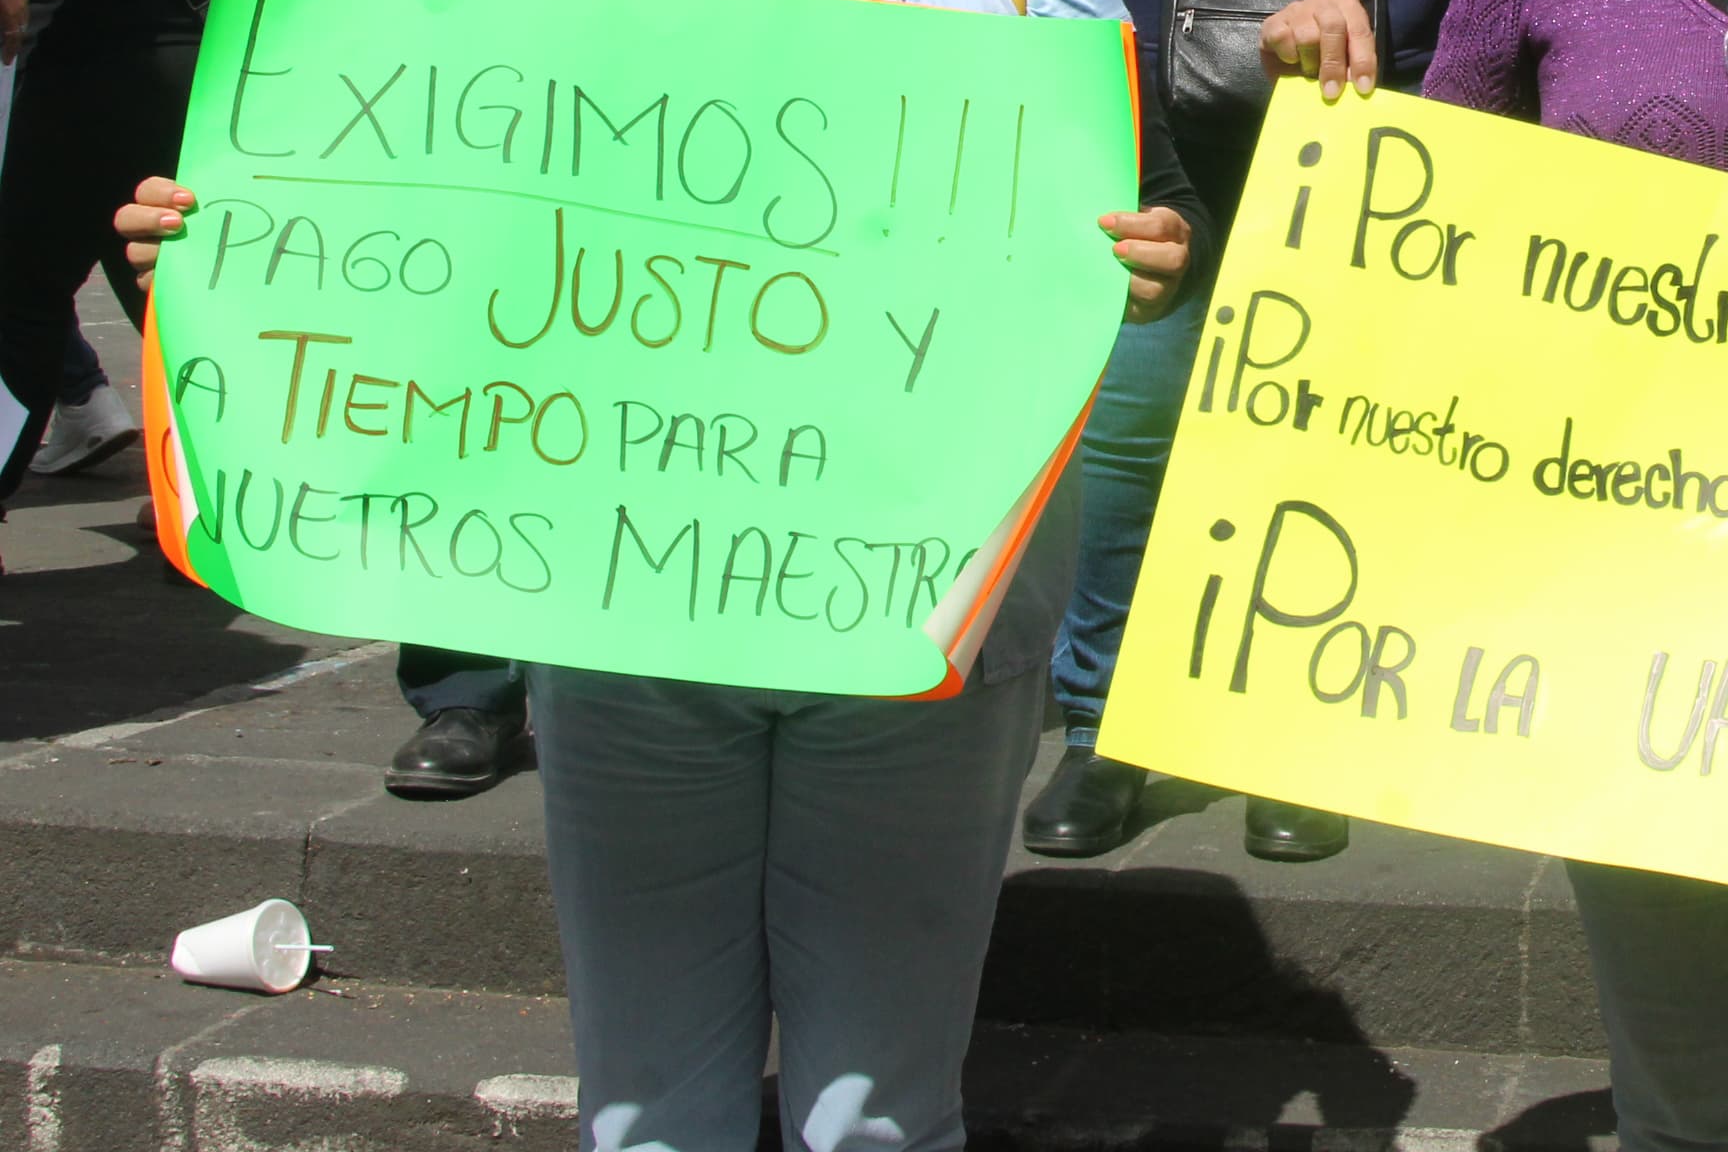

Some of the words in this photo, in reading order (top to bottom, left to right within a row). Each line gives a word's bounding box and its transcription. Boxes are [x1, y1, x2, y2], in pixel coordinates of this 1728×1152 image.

[202, 198, 455, 295] PAGO
[883, 307, 941, 393] Y
[175, 356, 228, 423] A
[612, 398, 830, 487] PARA
[1340, 395, 1510, 484] nuestro
[1451, 646, 1541, 738] LA
